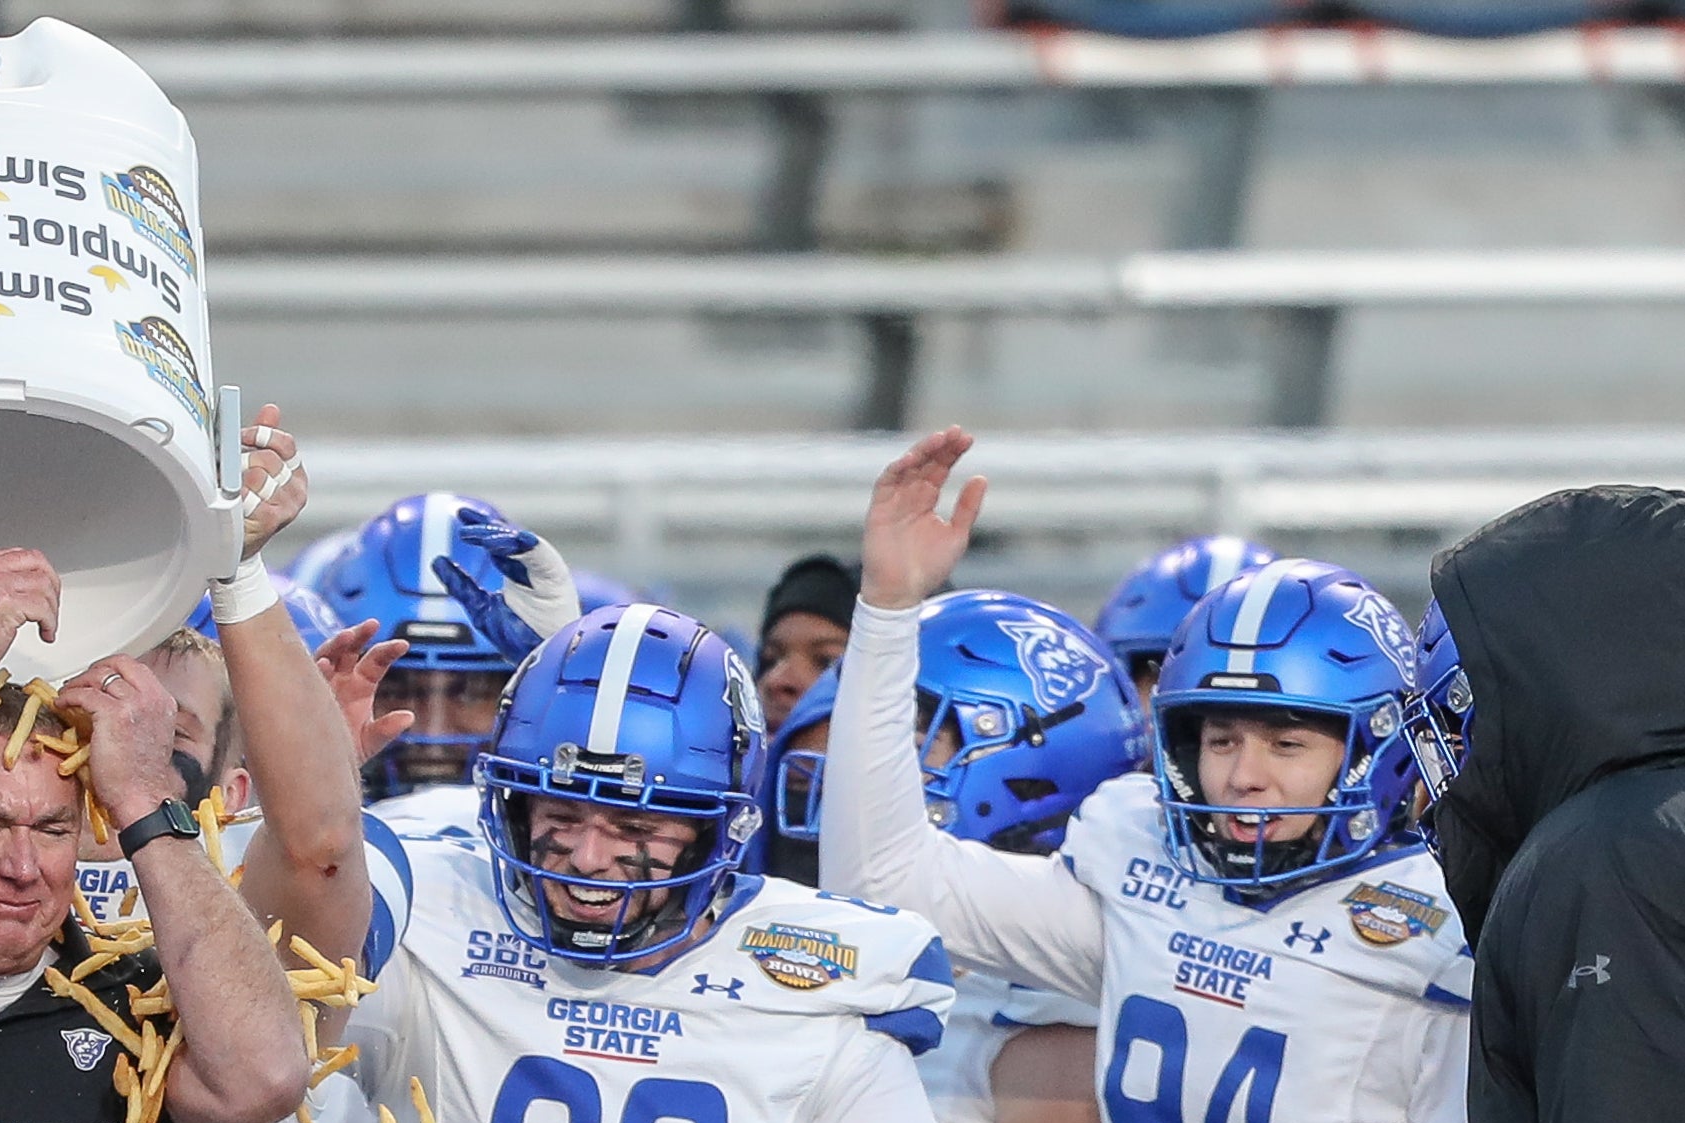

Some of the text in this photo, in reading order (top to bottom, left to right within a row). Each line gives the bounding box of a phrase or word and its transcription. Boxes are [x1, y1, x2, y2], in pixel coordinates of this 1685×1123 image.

[135, 174, 184, 223] BOWL
[7, 213, 182, 314] Simplot
[148, 323, 195, 375] BOWL
[1122, 857, 1195, 910] SBC
[467, 929, 547, 970] SBC
[1168, 932, 1273, 981] GEORGIA
[471, 963, 538, 983] GRADUATE
[766, 960, 824, 983] BOWL
[1175, 961, 1252, 1001] STATE
[547, 997, 684, 1037] GEORGIA
[564, 1026, 661, 1057] STATE
